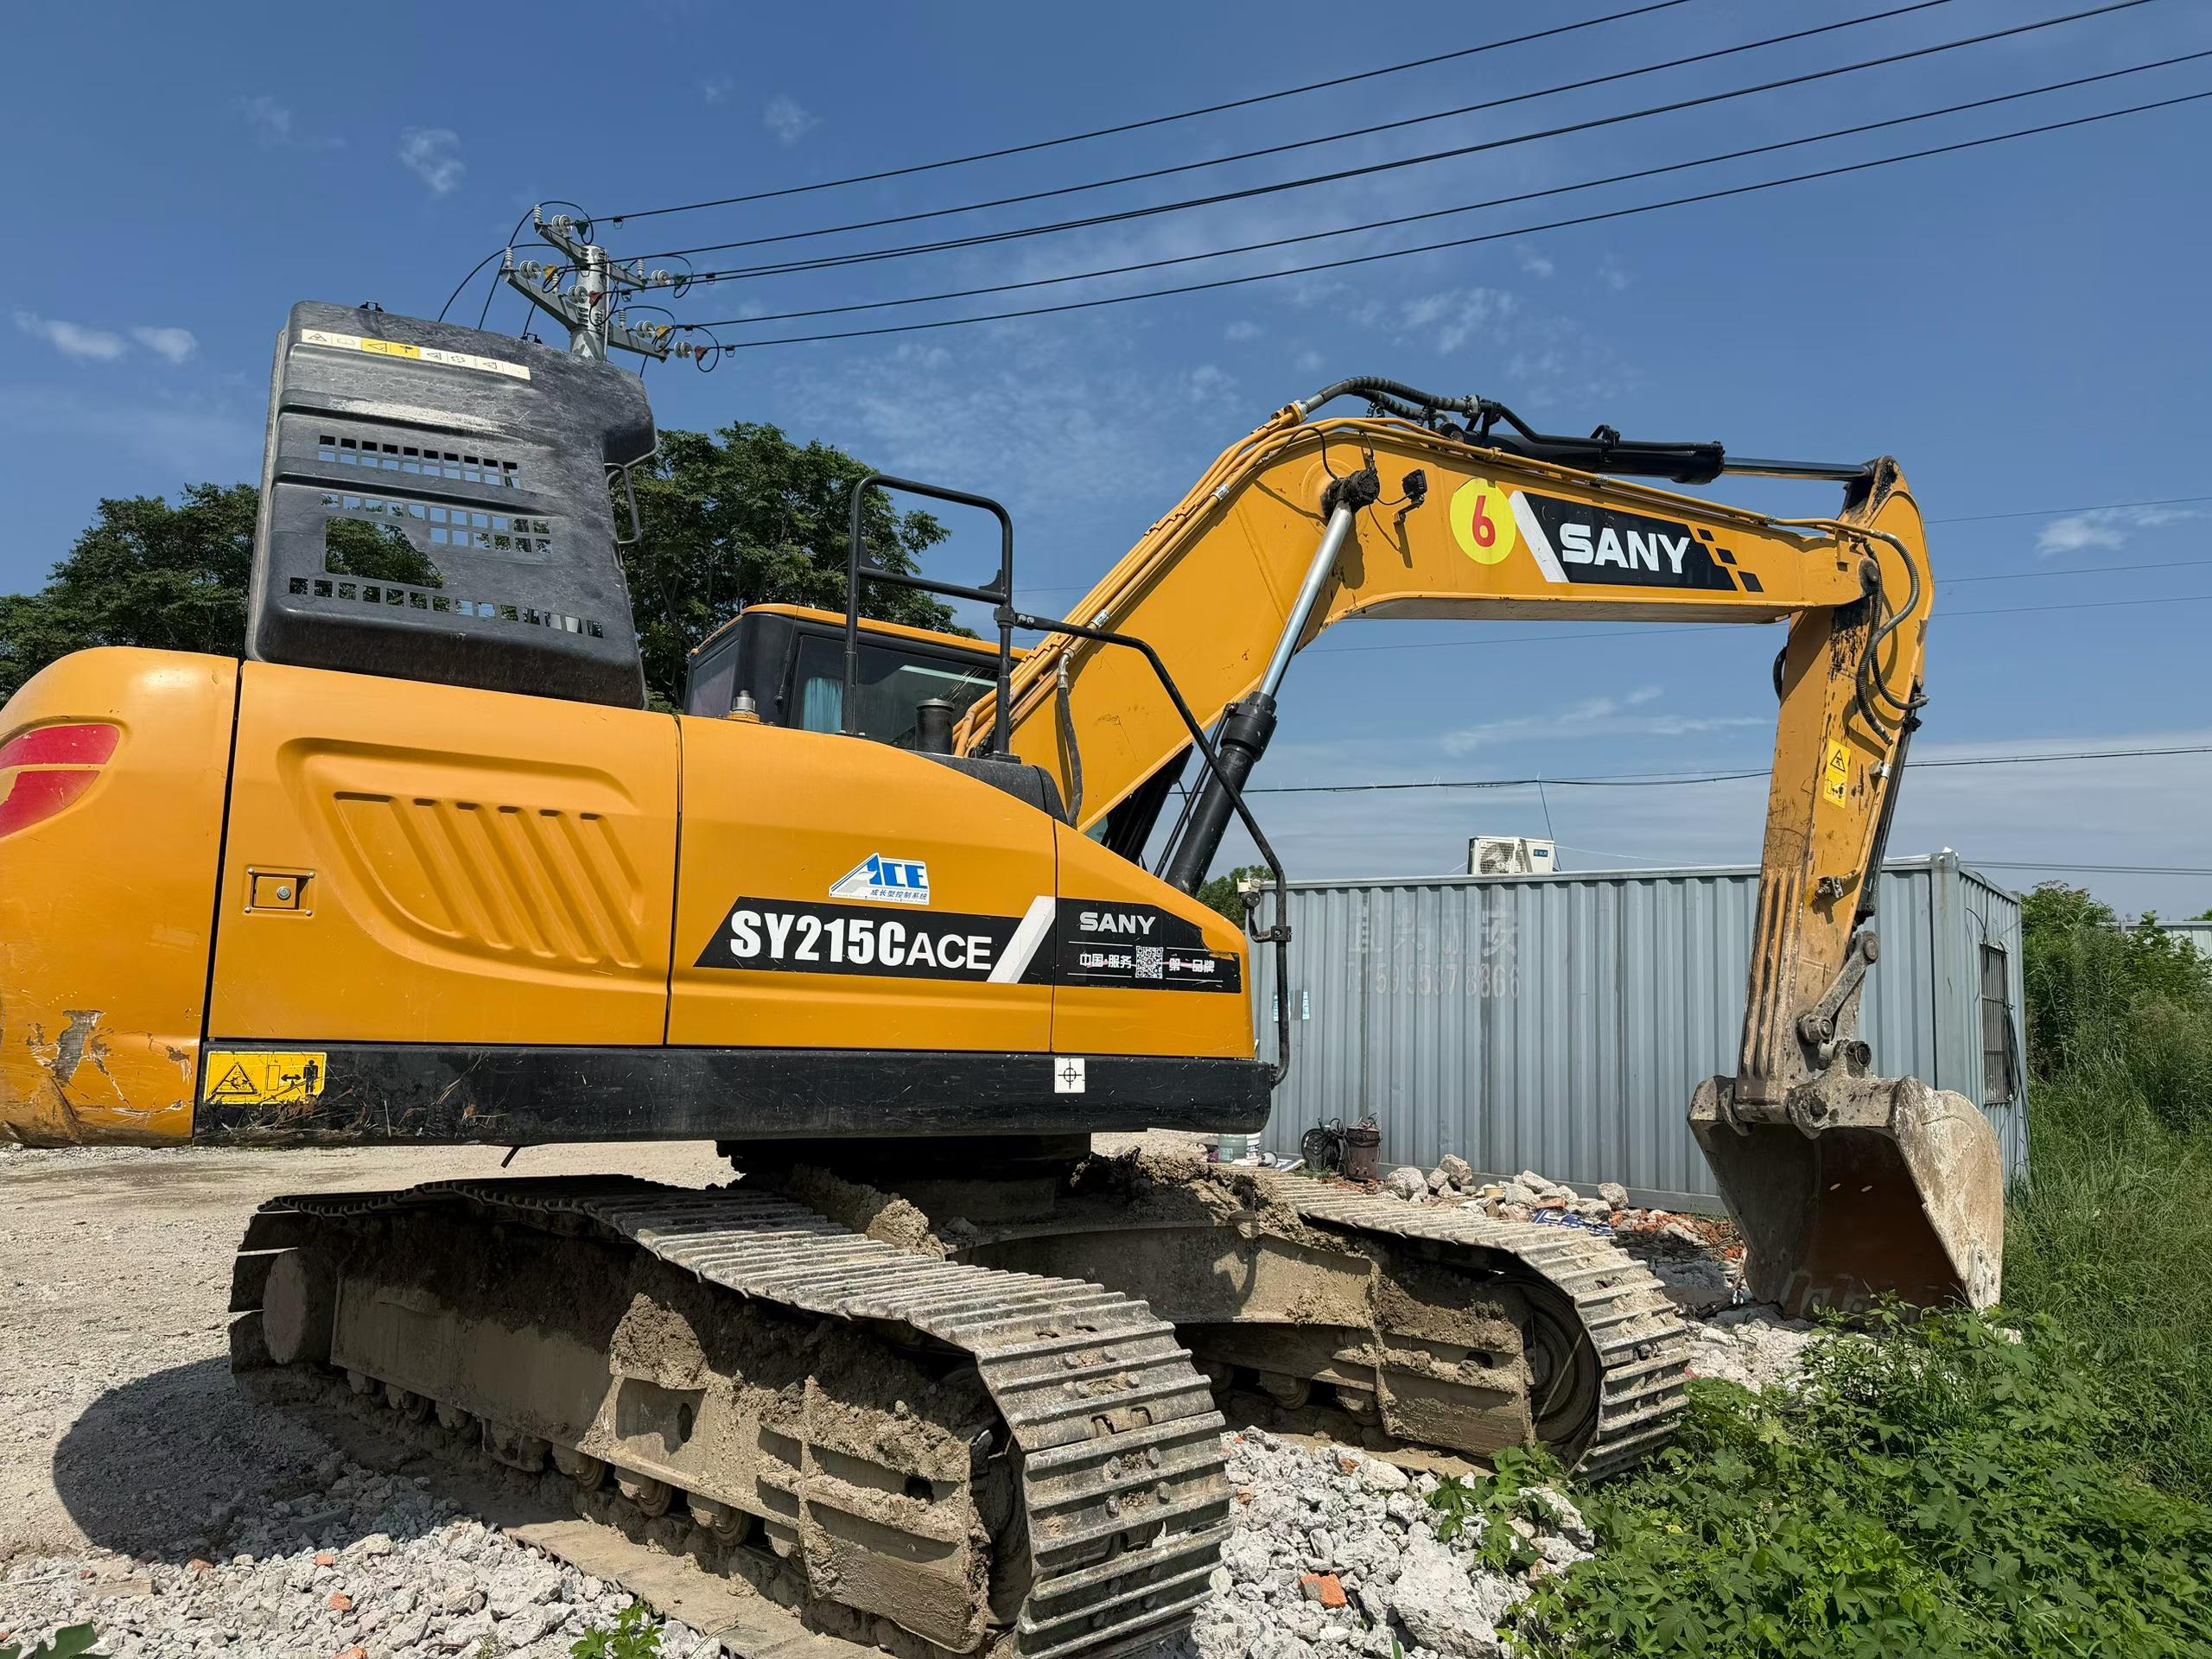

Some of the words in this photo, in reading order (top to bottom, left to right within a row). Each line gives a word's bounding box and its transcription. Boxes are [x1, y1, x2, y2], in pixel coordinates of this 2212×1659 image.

[1471, 494, 1496, 548] 6
[1559, 522, 1690, 575] SANY
[870, 888, 928, 901] 成长型控制系统
[1079, 912, 1156, 935] SANY
